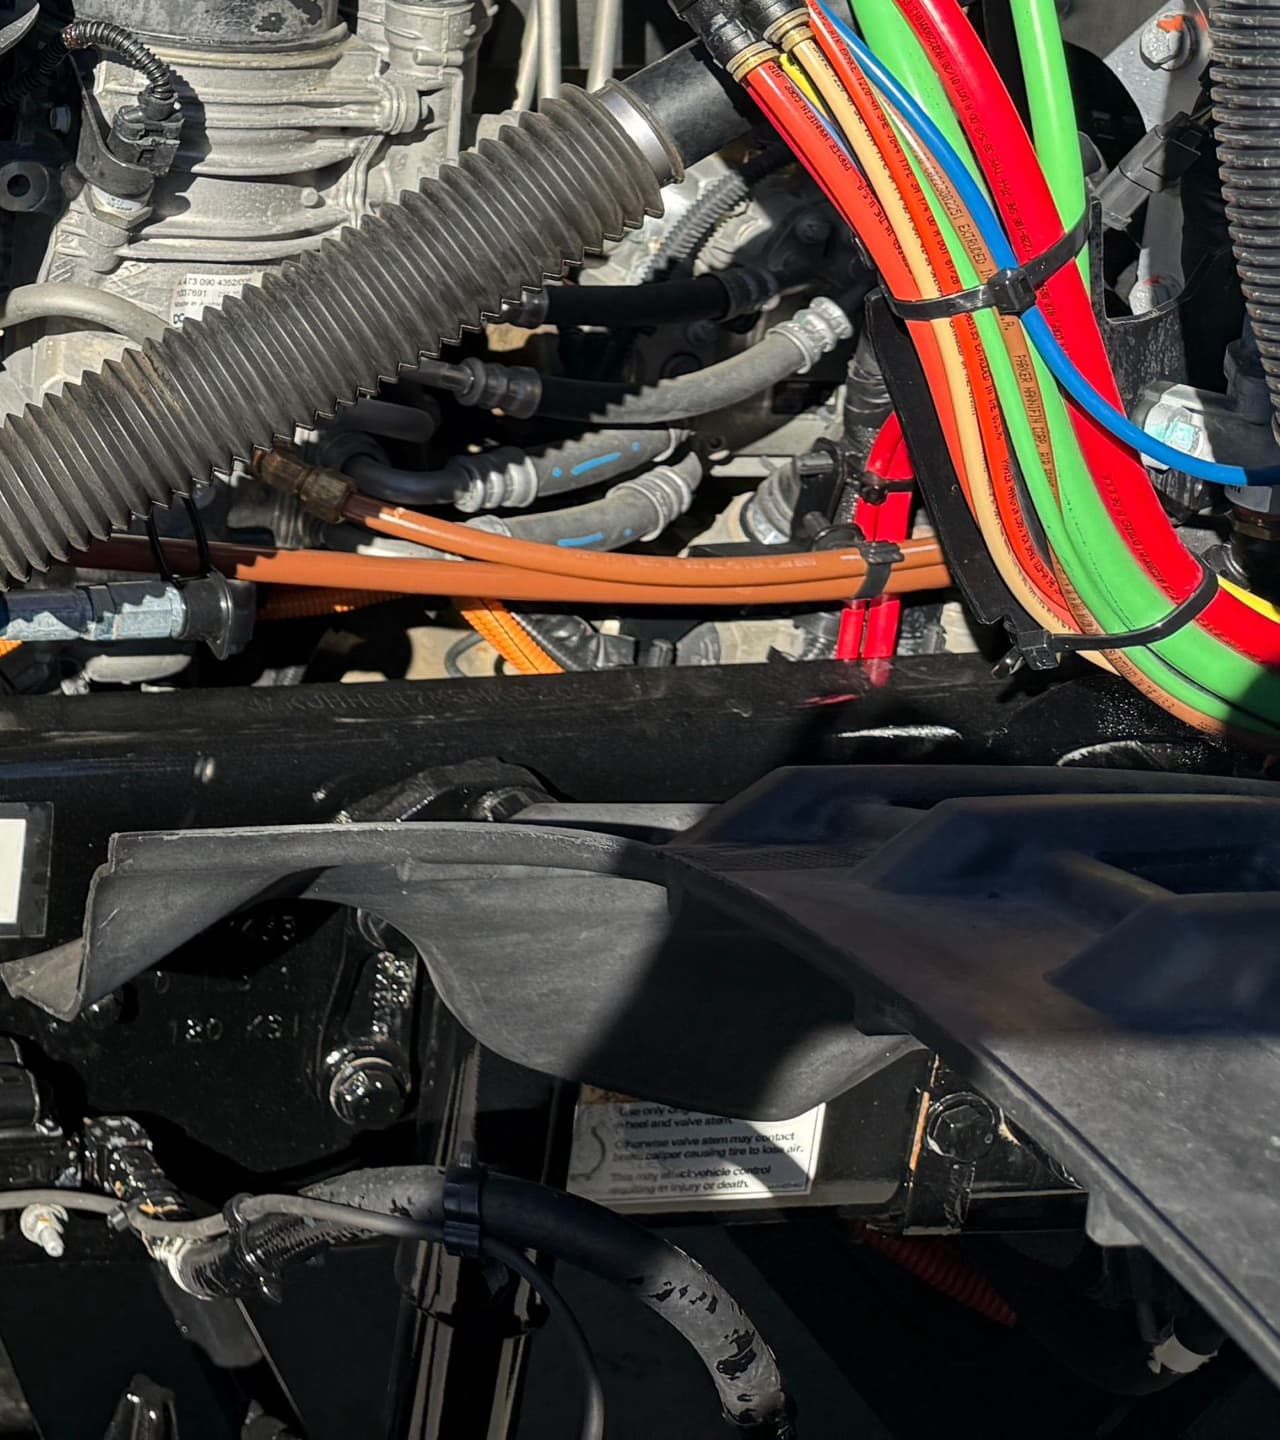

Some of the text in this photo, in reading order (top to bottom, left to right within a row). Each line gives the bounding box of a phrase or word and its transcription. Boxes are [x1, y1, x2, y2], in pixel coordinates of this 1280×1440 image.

[767, 62, 782, 80] AIR
[954, 85, 970, 103] DOT
[827, 141, 852, 172] PARKER
[955, 220, 989, 267] EXTRUDED
[1011, 351, 1034, 385] PARKER
[1019, 383, 1046, 425] HANNIFIN
[651, 1118, 671, 1128] and
[673, 1117, 703, 1128] valve
[672, 1132, 795, 1147] valve stem may contact
[684, 1146, 726, 1160] causing
[729, 1145, 747, 1157] tire
[749, 1145, 760, 1156] to
[786, 1143, 804, 1154] air.
[693, 1164, 771, 1179] vehicle control
[670, 1178, 749, 1194] injury or death.
